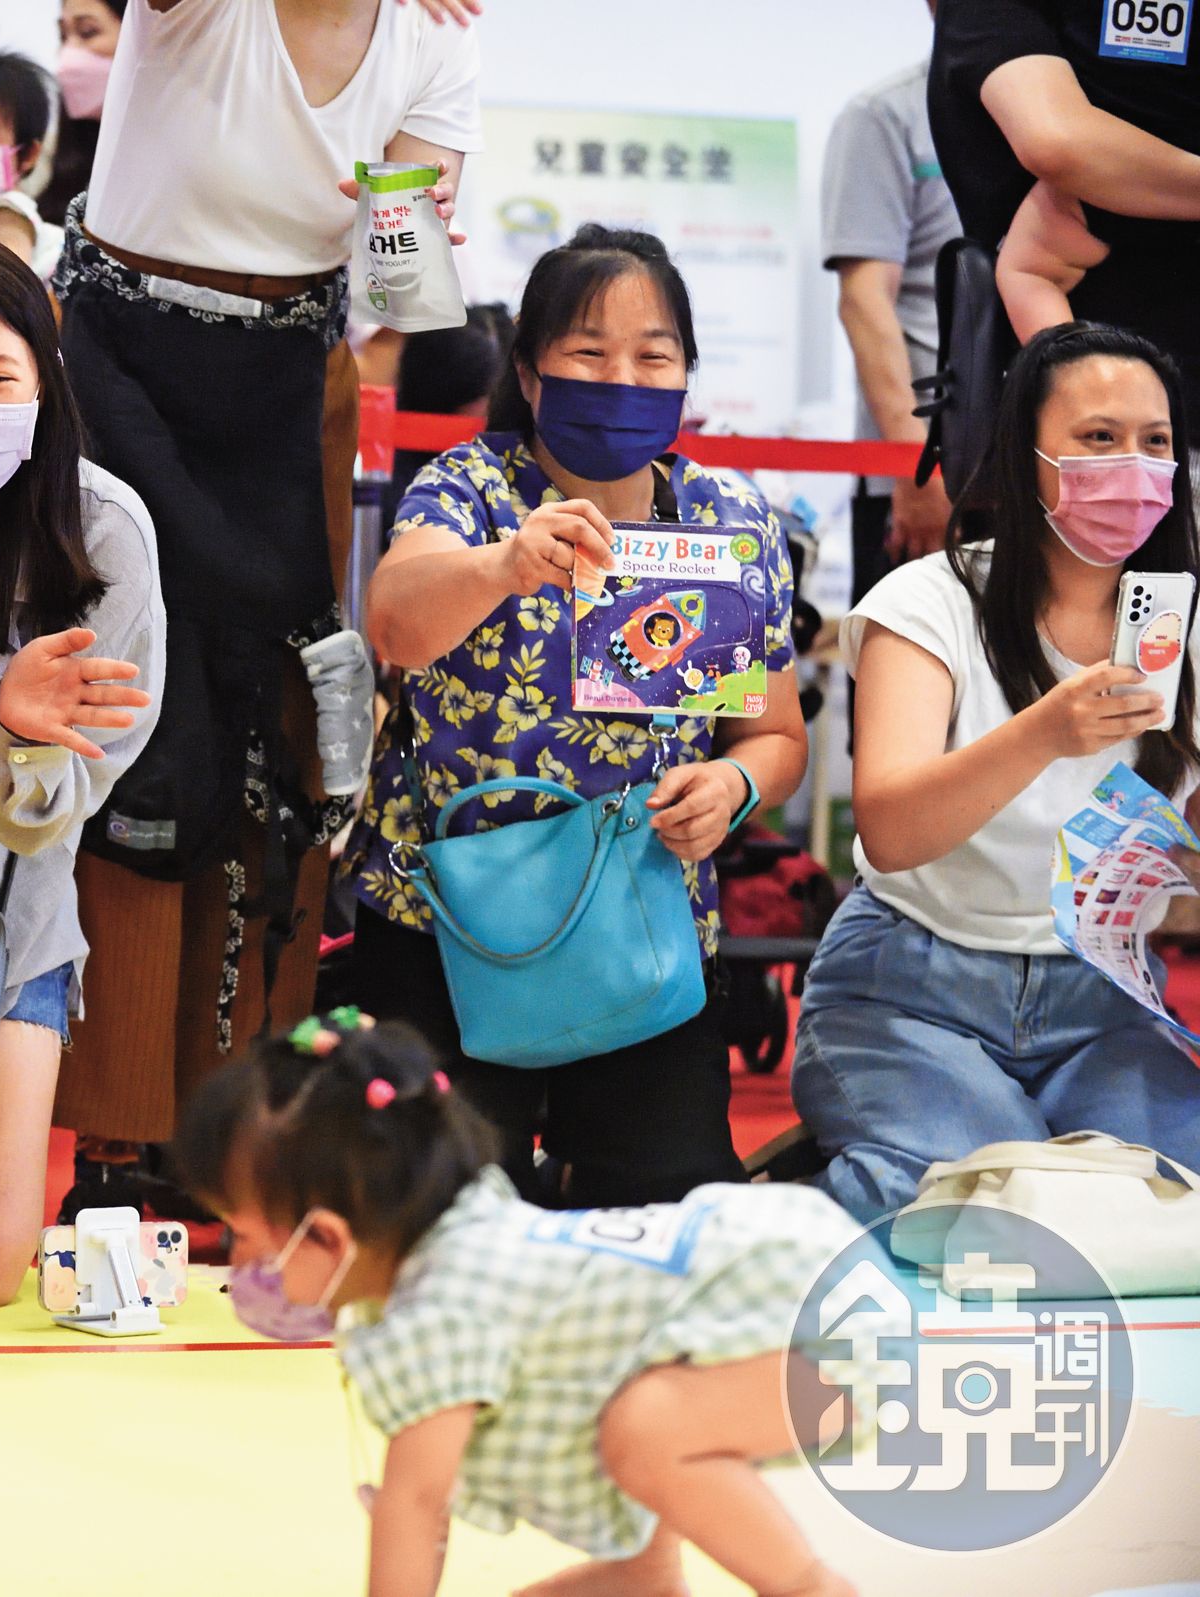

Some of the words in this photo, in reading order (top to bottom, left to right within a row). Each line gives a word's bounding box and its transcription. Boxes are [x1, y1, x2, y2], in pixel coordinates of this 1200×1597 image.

[1112, 0, 1184, 37] 050
[611, 535, 669, 562] Bizzy
[676, 538, 728, 561] Bear
[623, 561, 665, 574] Space
[669, 562, 717, 575] Rocket
